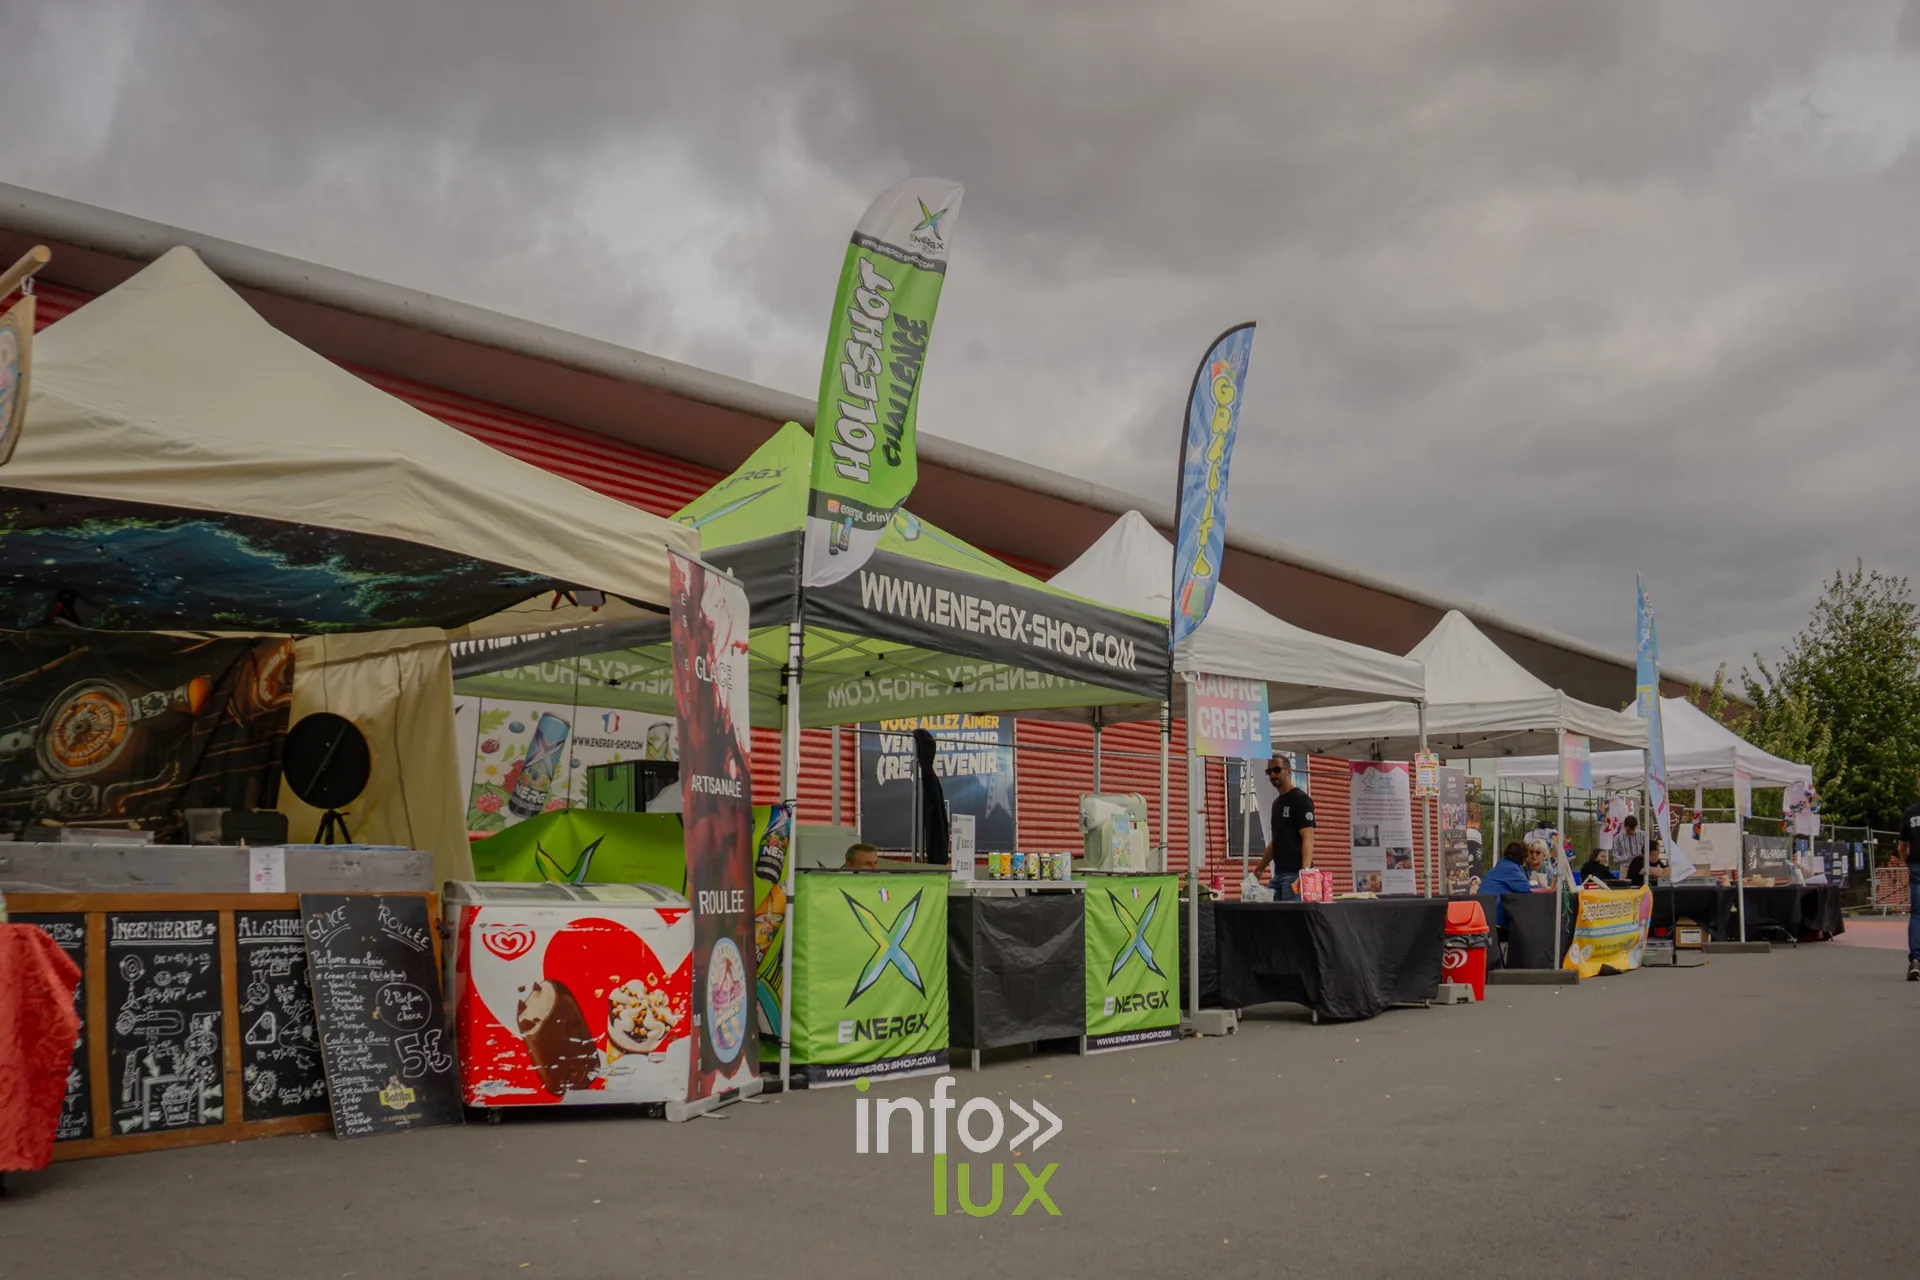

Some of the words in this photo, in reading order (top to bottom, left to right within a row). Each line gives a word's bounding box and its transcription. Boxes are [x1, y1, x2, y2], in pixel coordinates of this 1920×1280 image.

[835, 256, 896, 484] HOLESHOT
[860, 570, 1137, 670] WWW.ENERGX-SHOP.COM
[880, 717, 918, 731] VOUS
[920, 714, 960, 730] ALLEZ
[961, 714, 999, 729] AIMER
[1198, 706, 1263, 741] CREPE
[691, 774, 742, 798] ARTISANALE
[698, 888, 745, 915] ROULEE
[1103, 990, 1170, 1017] ENERGX
[837, 1011, 929, 1044] ENERGX
